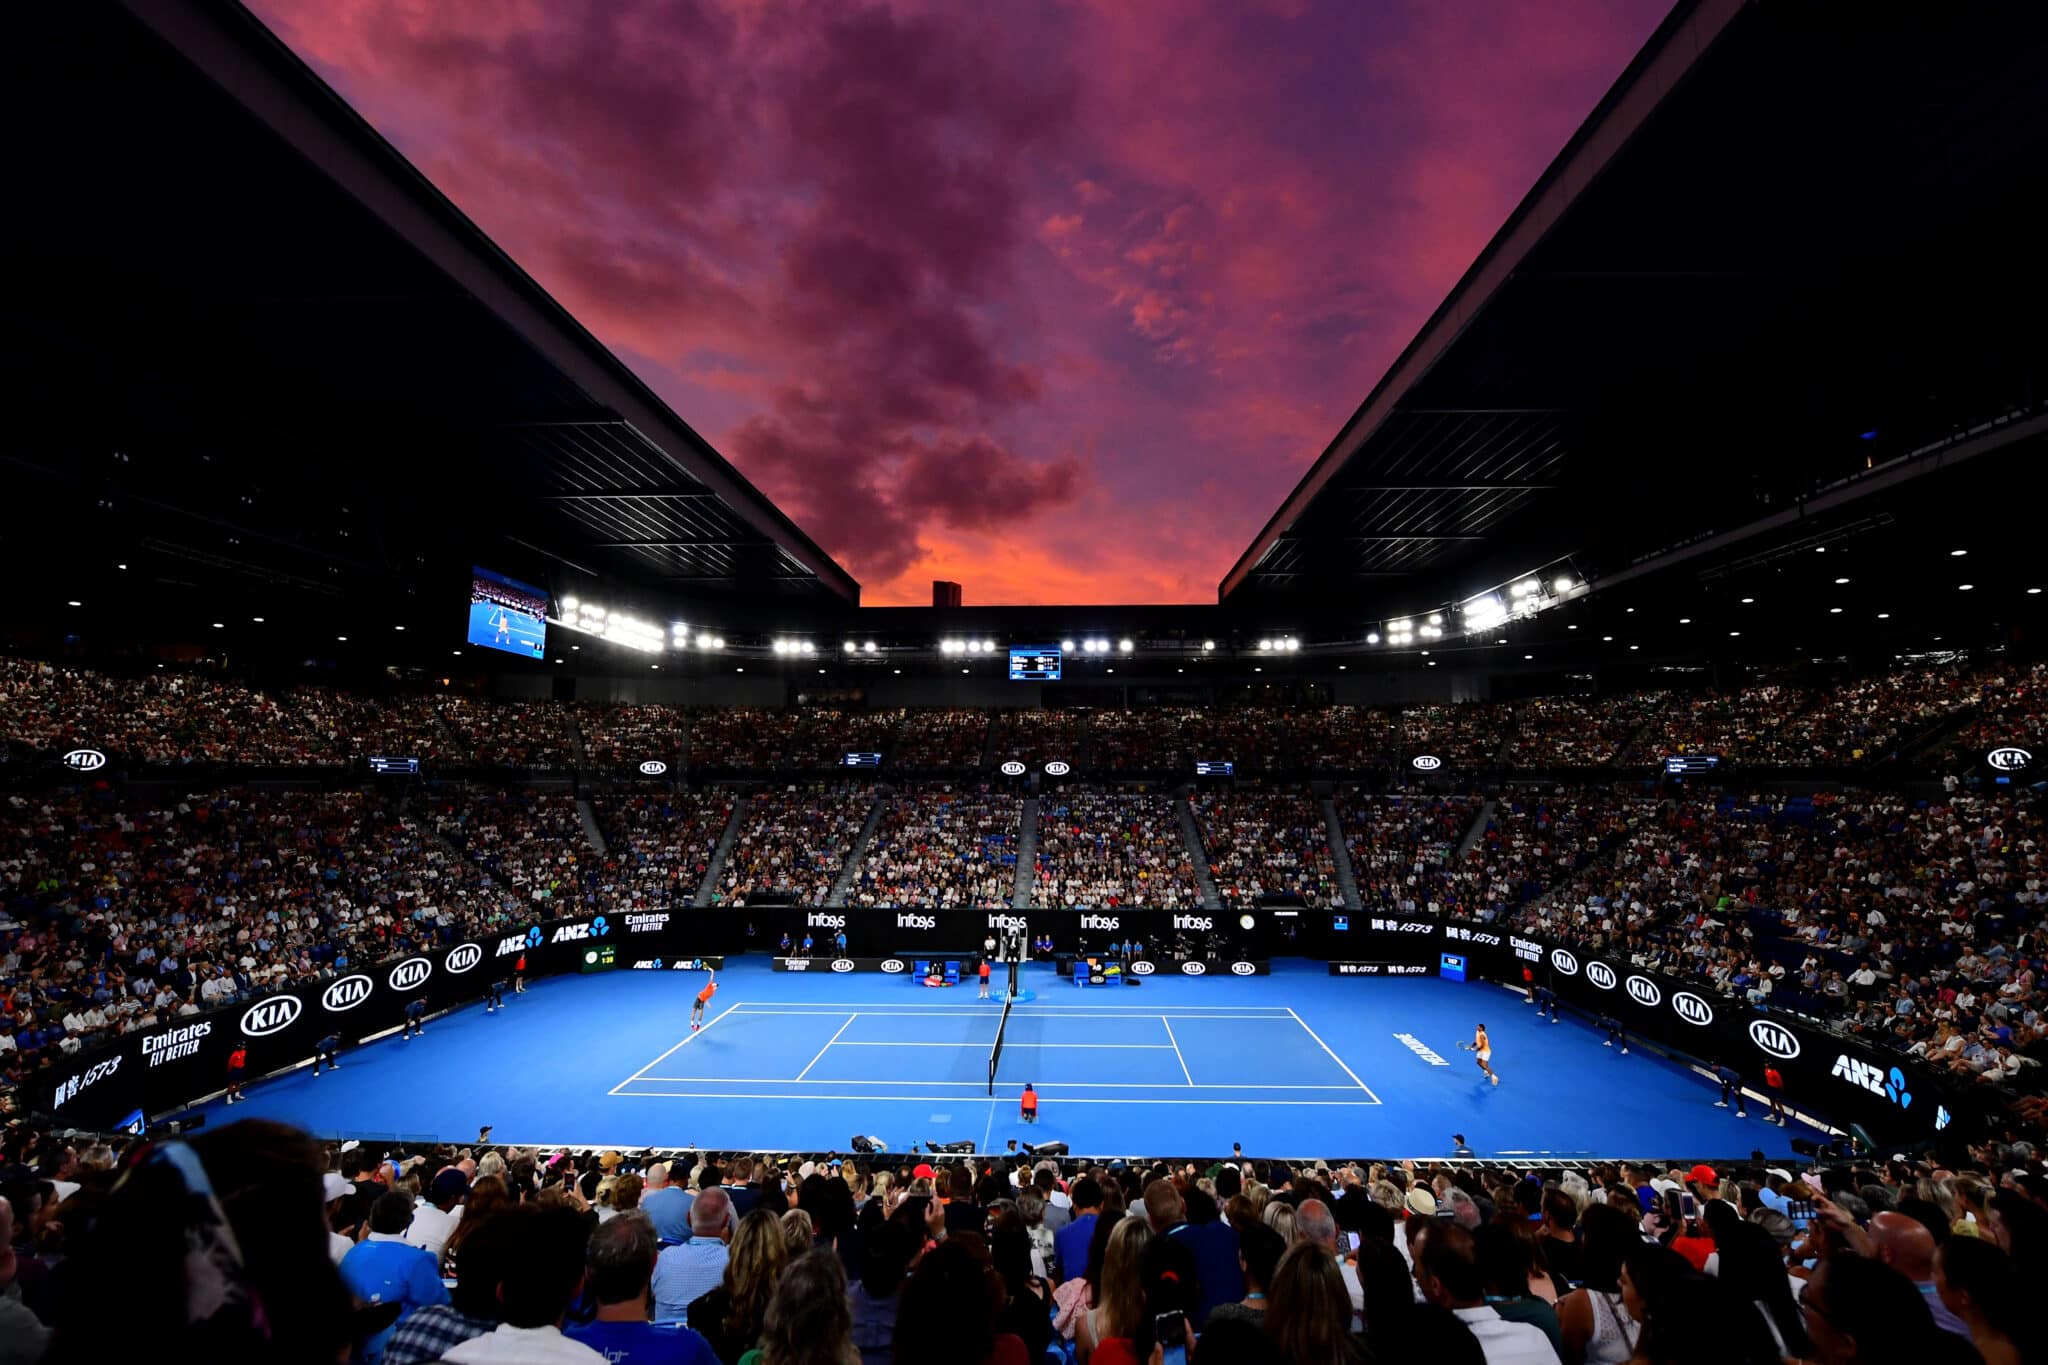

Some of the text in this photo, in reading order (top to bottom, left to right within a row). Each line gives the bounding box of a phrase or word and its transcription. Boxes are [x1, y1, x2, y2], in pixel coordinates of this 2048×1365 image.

[625, 913, 670, 926] Emirates
[808, 913, 846, 929] Infosys
[897, 913, 935, 930] Infosys
[1081, 914, 1120, 931] Infosys
[1173, 914, 1213, 931] Infosys
[552, 923, 590, 943] ANZ
[495, 934, 526, 957] ANZ
[1510, 935, 1543, 954] Emirates
[142, 1021, 211, 1055] Emirates
[150, 1039, 200, 1068] FLY BETTER
[1832, 1054, 1886, 1098] ANZ
